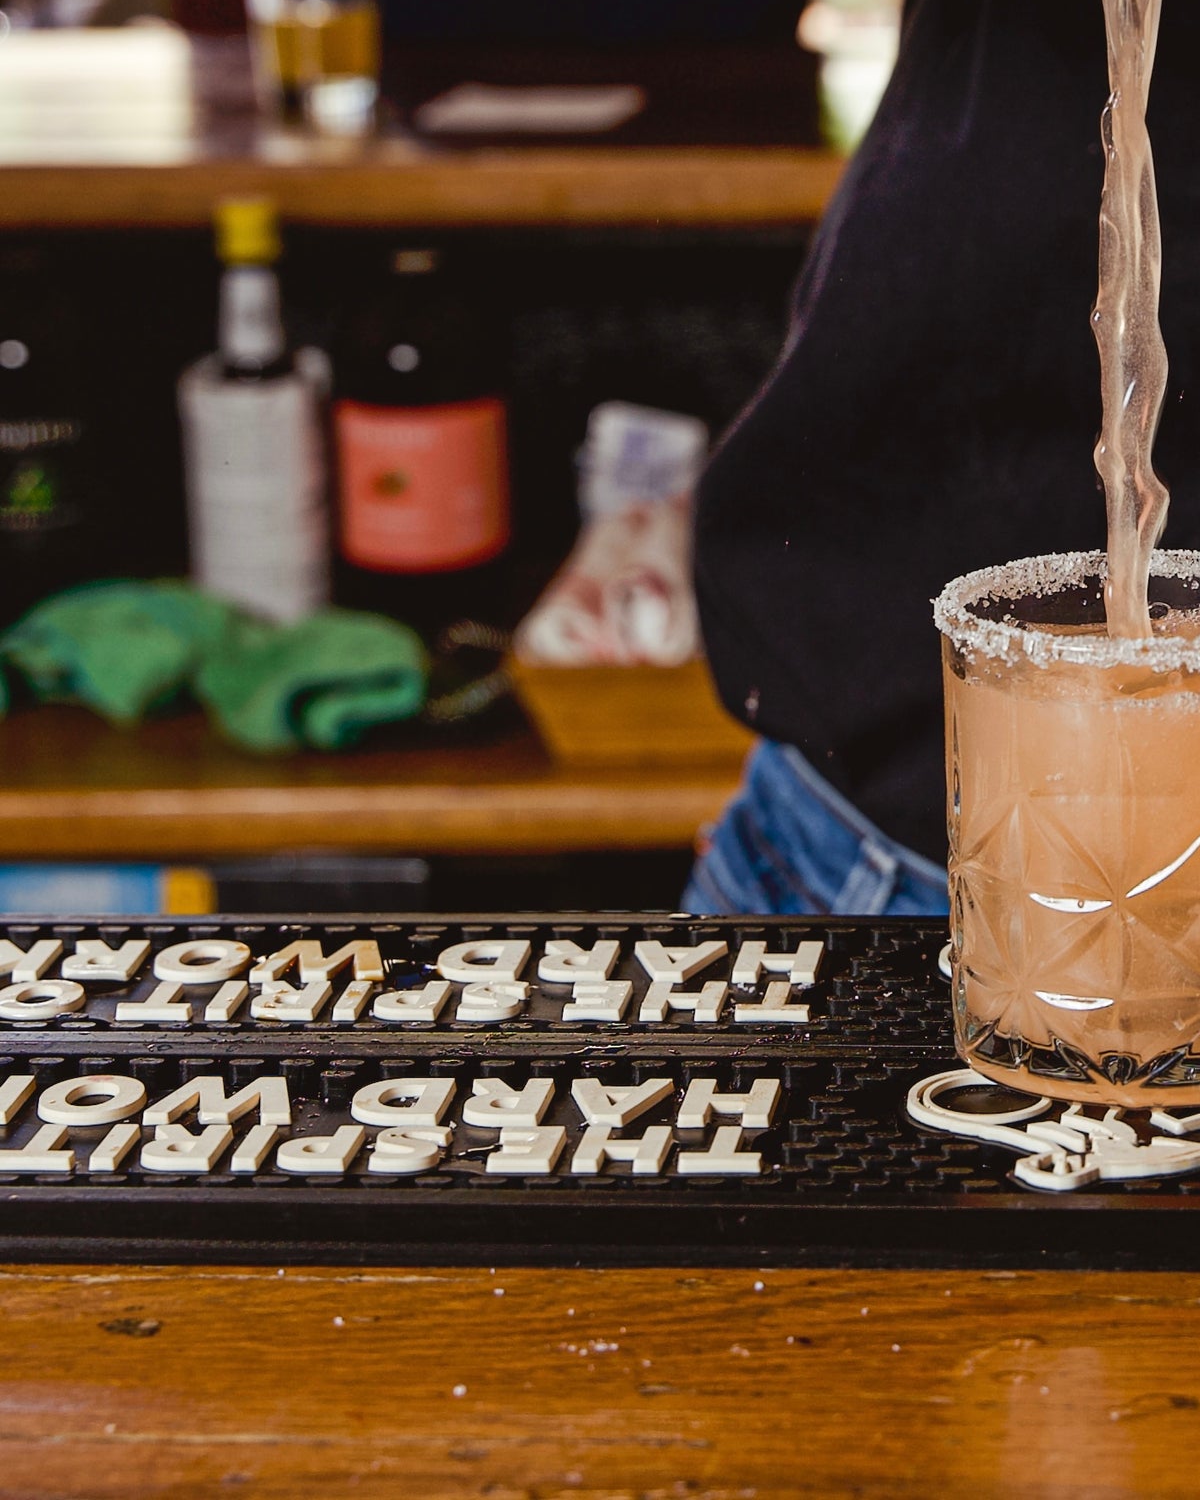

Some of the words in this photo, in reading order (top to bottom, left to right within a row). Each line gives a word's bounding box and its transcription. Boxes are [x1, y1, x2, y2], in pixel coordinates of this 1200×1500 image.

[0, 939, 384, 984] WORK
[437, 939, 824, 984] HARD
[115, 980, 531, 1022] SPIRIT
[563, 980, 811, 1023] THE
[351, 1077, 782, 1129] HARD
[0, 1123, 453, 1173] SPIRIT
[485, 1125, 763, 1174] THE
